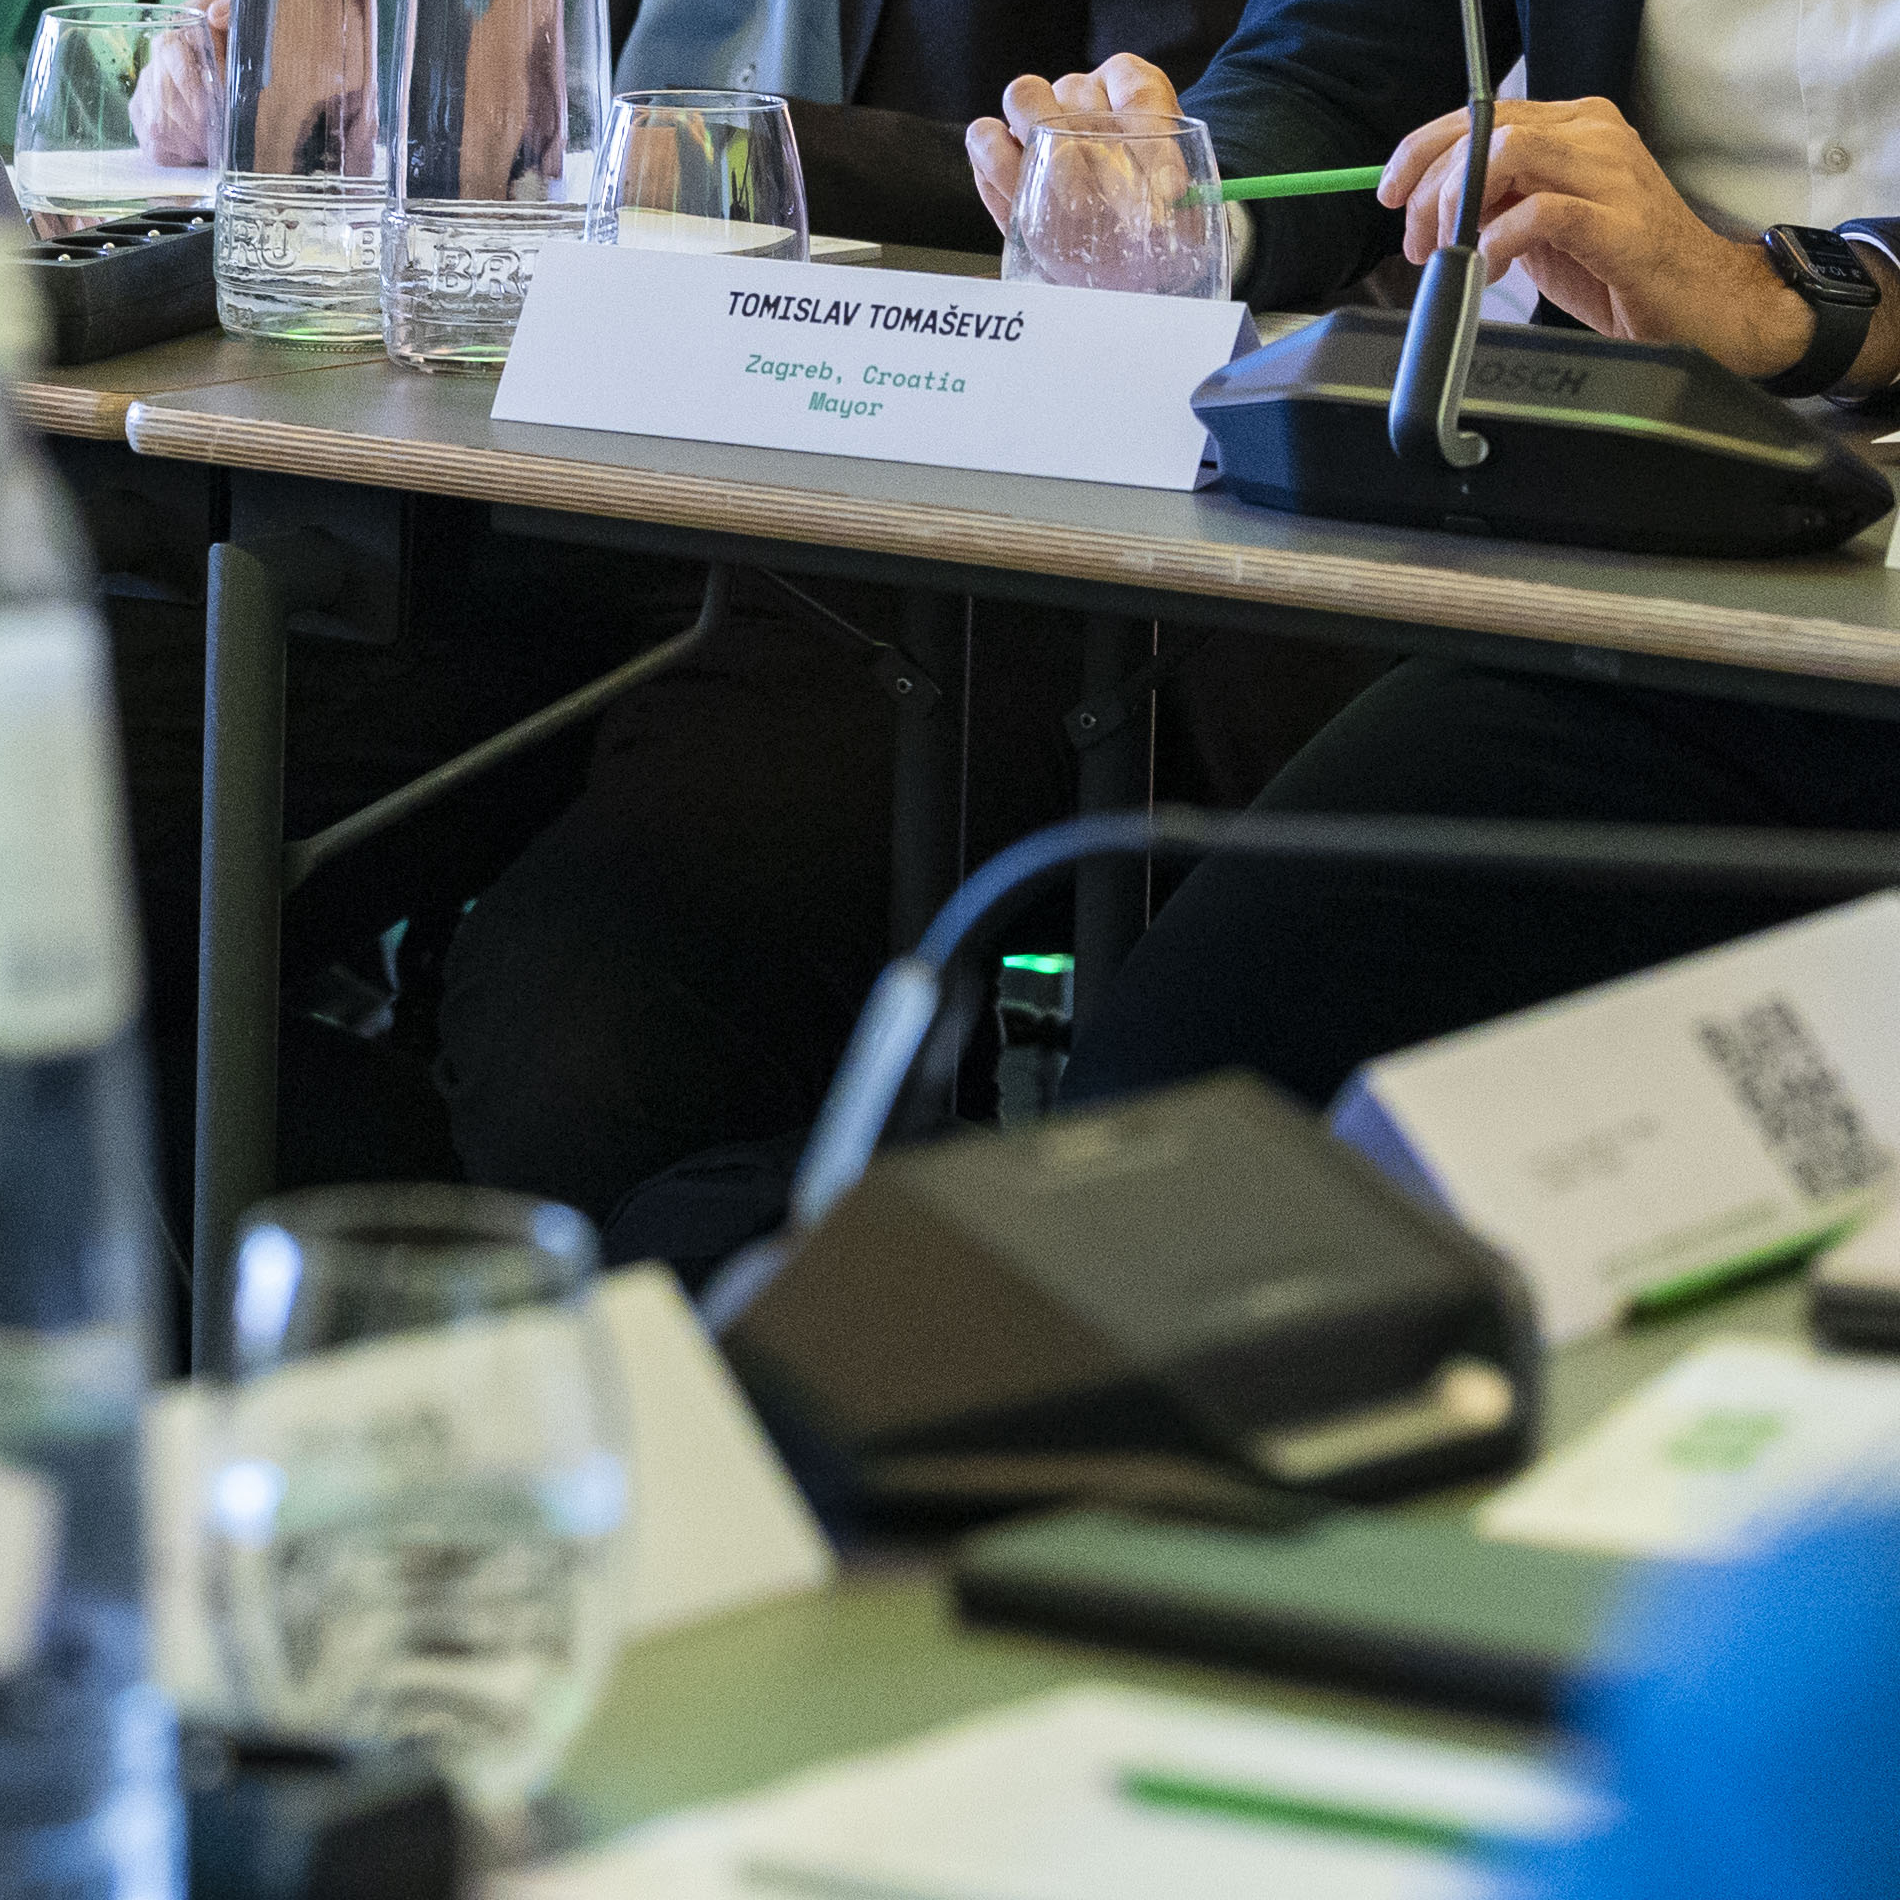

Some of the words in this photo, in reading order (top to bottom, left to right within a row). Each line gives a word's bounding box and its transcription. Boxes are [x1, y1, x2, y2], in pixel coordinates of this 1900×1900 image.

[728, 291, 861, 327] TOMISLAV
[868, 303, 1025, 342] TOMAŠEVIĆ
[744, 353, 844, 386] Zagreb,
[862, 365, 966, 394] Croatia
[1470, 360, 1589, 397] OSCH
[808, 391, 884, 418] Mayor
